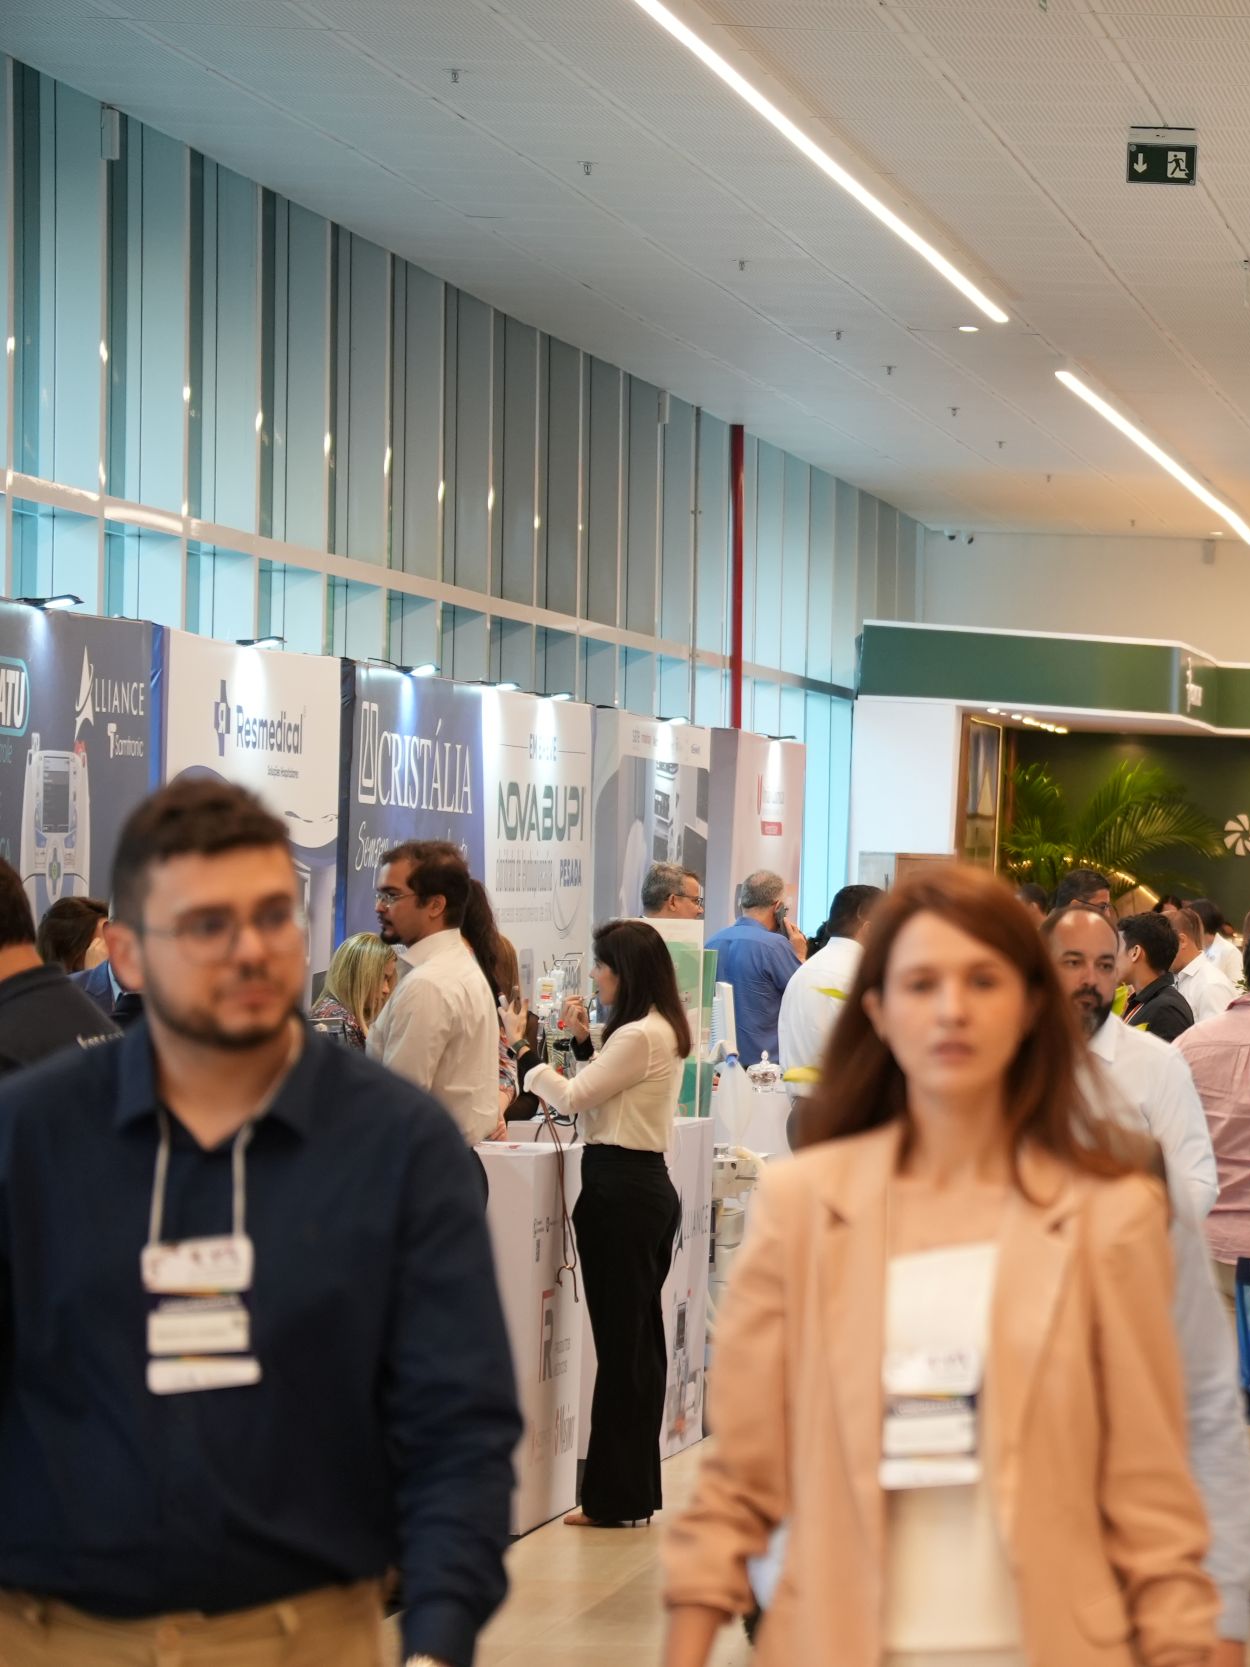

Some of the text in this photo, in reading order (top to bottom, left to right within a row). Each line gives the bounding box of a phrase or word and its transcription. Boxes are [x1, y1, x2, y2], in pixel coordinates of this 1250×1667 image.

[236, 704, 303, 755] Resmedical
[377, 718, 473, 815] CRISTÁLIA
[497, 780, 587, 843] NOVABUPI
[559, 858, 582, 889] PESADA
